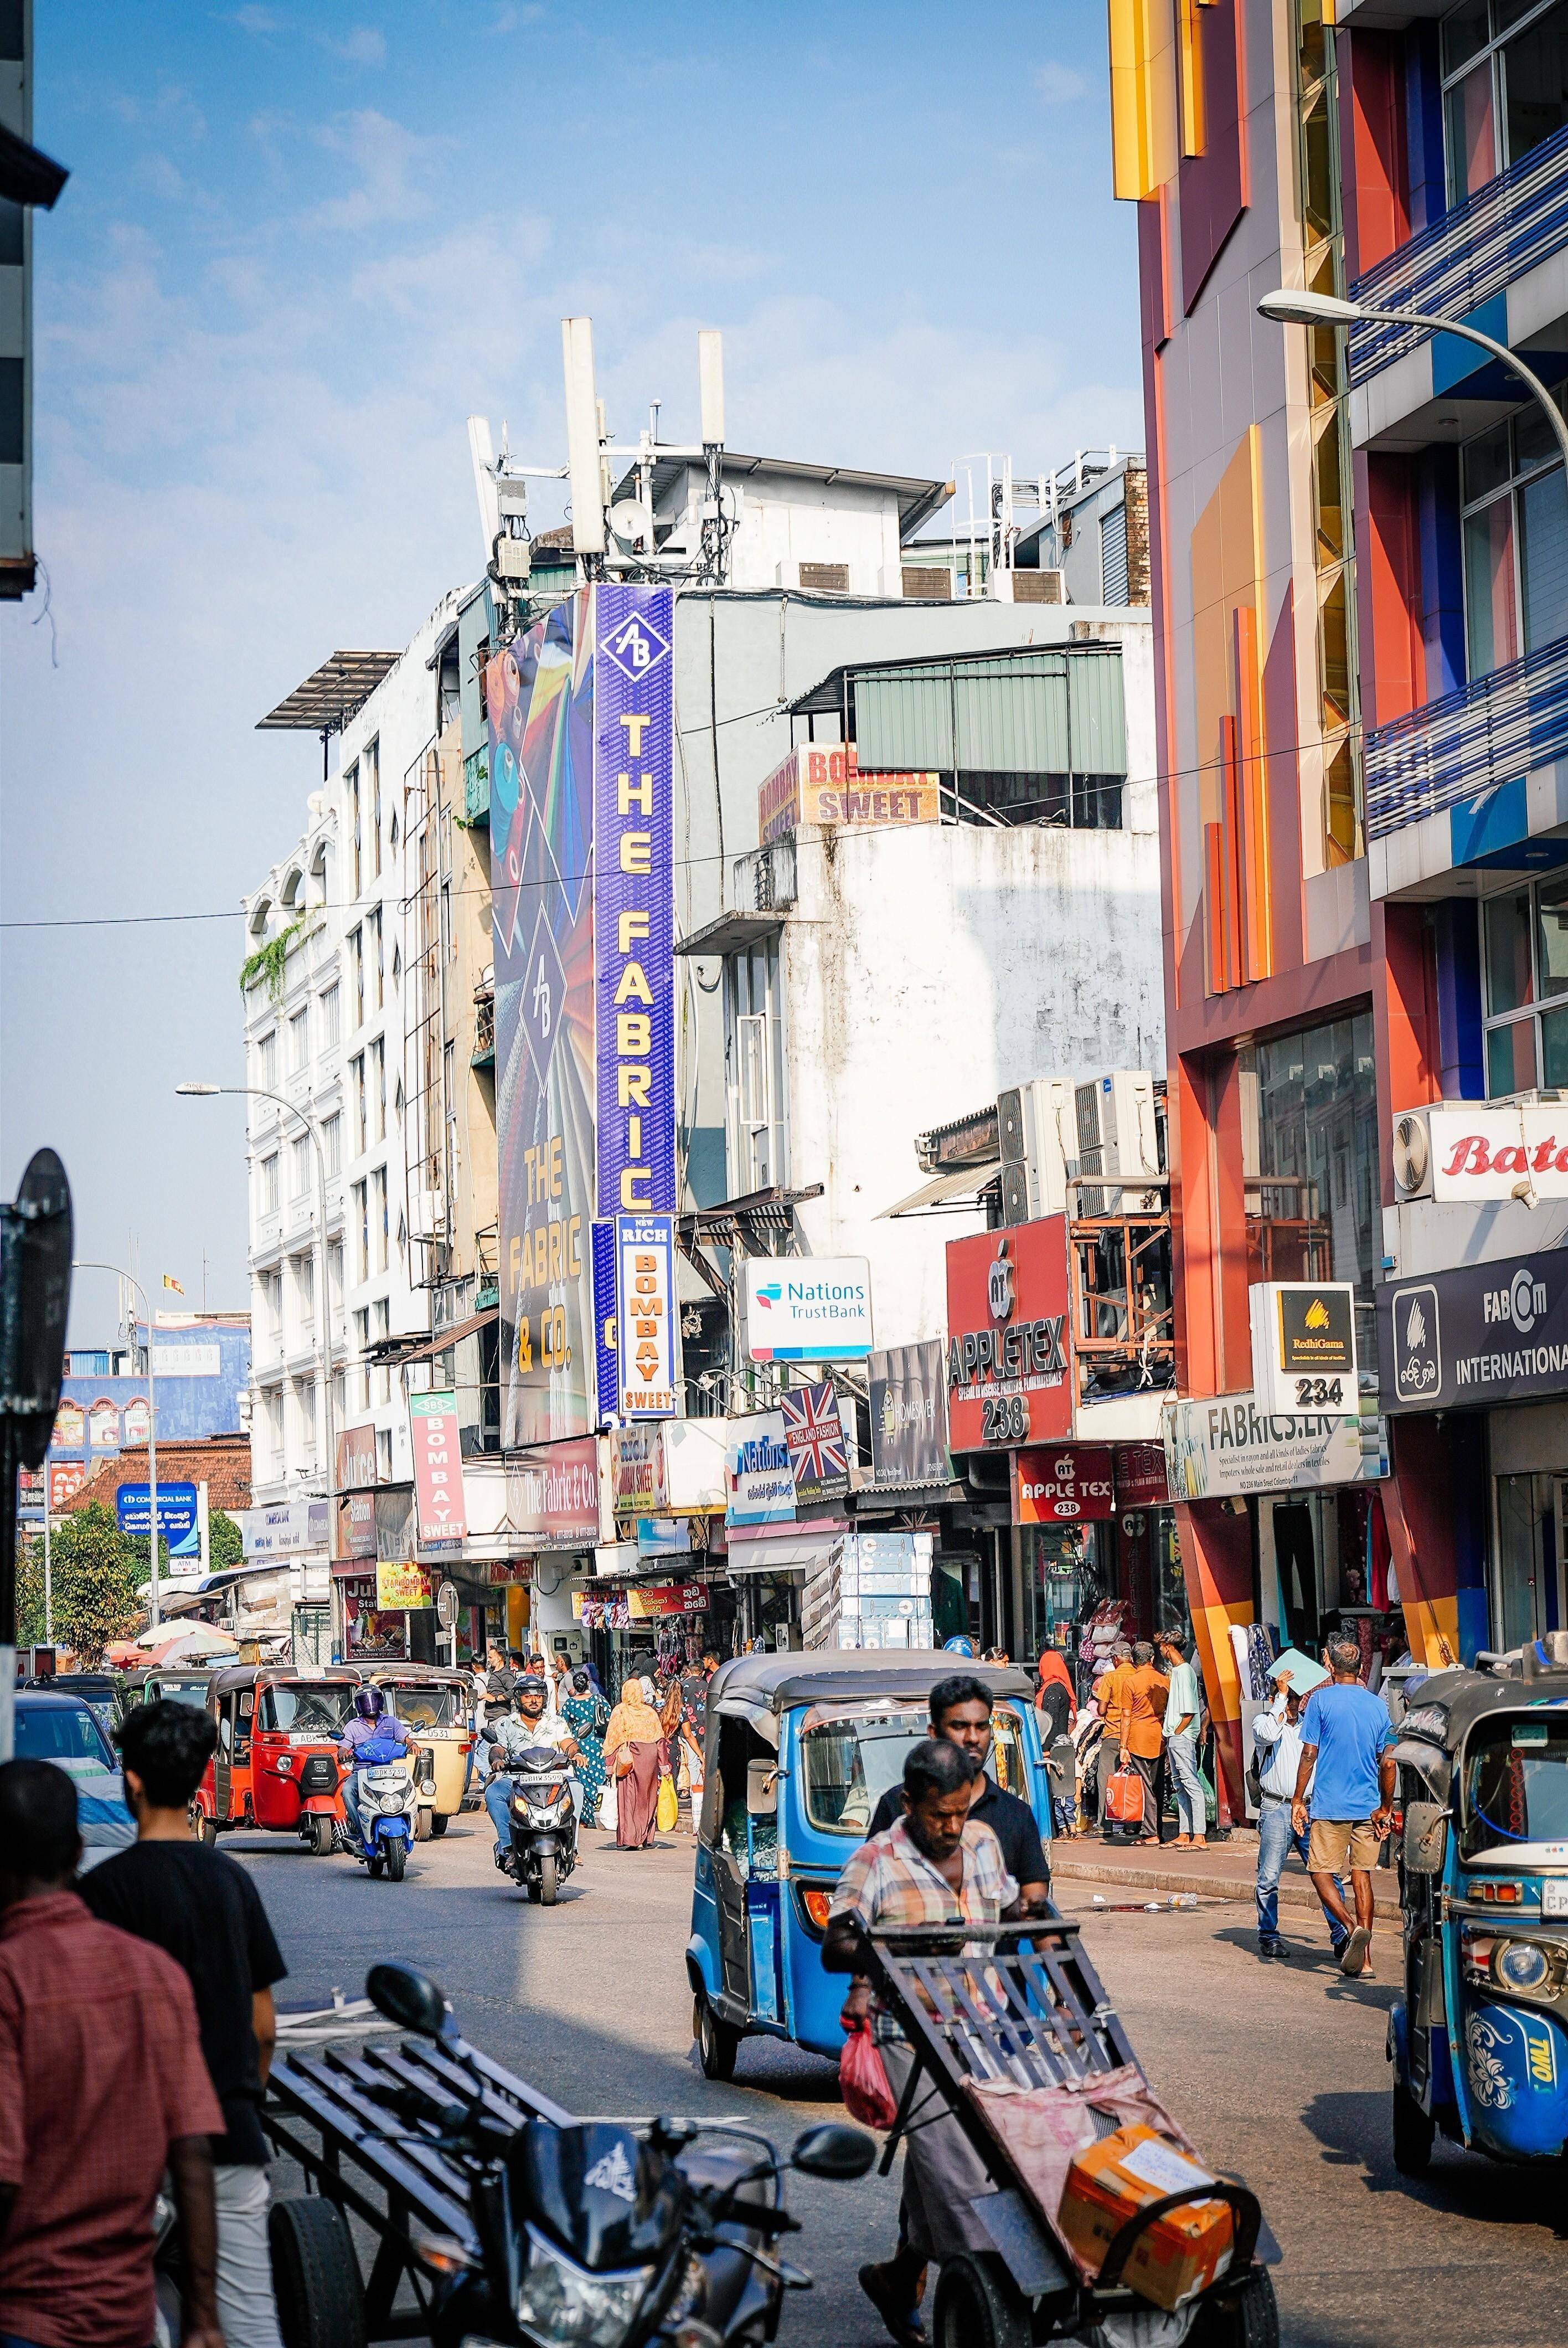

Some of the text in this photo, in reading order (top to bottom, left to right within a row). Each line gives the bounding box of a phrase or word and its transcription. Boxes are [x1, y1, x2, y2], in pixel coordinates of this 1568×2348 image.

[760, 755, 799, 823] BOMBAY
[818, 792, 923, 820] SWEET
[613, 714, 656, 1211] THE FABRIC
[524, 1136, 563, 1207] THE
[621, 1229, 668, 1243] RICH
[509, 1214, 582, 1295] FABRIC
[788, 1283, 864, 1300] Nations
[630, 1255, 662, 1381] BOMBAY
[519, 1315, 534, 1374] &
[540, 1305, 571, 1371] CO.
[948, 1315, 1067, 1387] APPLETEX
[1292, 1338, 1344, 1350] RedhiGama
[625, 1392, 671, 1409] SWEET
[1296, 1378, 1344, 1405] 234
[424, 1400, 443, 1410] SBS
[895, 1399, 936, 1422] HOMESAVER
[982, 1396, 1028, 1440] 238
[792, 1422, 839, 1445] ENGLAND FASHION
[742, 1435, 788, 1474] Nations
[1219, 1453, 1240, 1468] Specialist
[1241, 1453, 1246, 1462] in
[1246, 1453, 1260, 1465] rayon
[1260, 1450, 1269, 1460] and
[1276, 1448, 1289, 1458] kinds
[1290, 1446, 1295, 1456] of
[1295, 1445, 1310, 1455] ladies
[1310, 1443, 1327, 1454] fabrics
[1241, 1464, 1255, 1475] whole
[1255, 1463, 1265, 1474] sale
[1265, 1463, 1274, 1472] and
[1275, 1461, 1287, 1471] retail
[1288, 1459, 1306, 1470] dealers
[1306, 1459, 1311, 1468] in
[1311, 1456, 1330, 1468] textiles
[427, 1417, 452, 1522] BOMBAY
[1058, 1464, 1071, 1475] AT
[524, 1461, 597, 1515] The Fabric & Co.
[1022, 1481, 1111, 1500] APPLE TEX
[350, 1497, 370, 1523] Station
[1058, 1504, 1076, 1513] 238
[423, 1523, 464, 1538] SWEET
[401, 1578, 429, 1586] BOMBAY
[301, 1734, 317, 1743] ABK
[1547, 1896, 1568, 1910] CP
[1529, 2037, 1553, 2083] TWO
